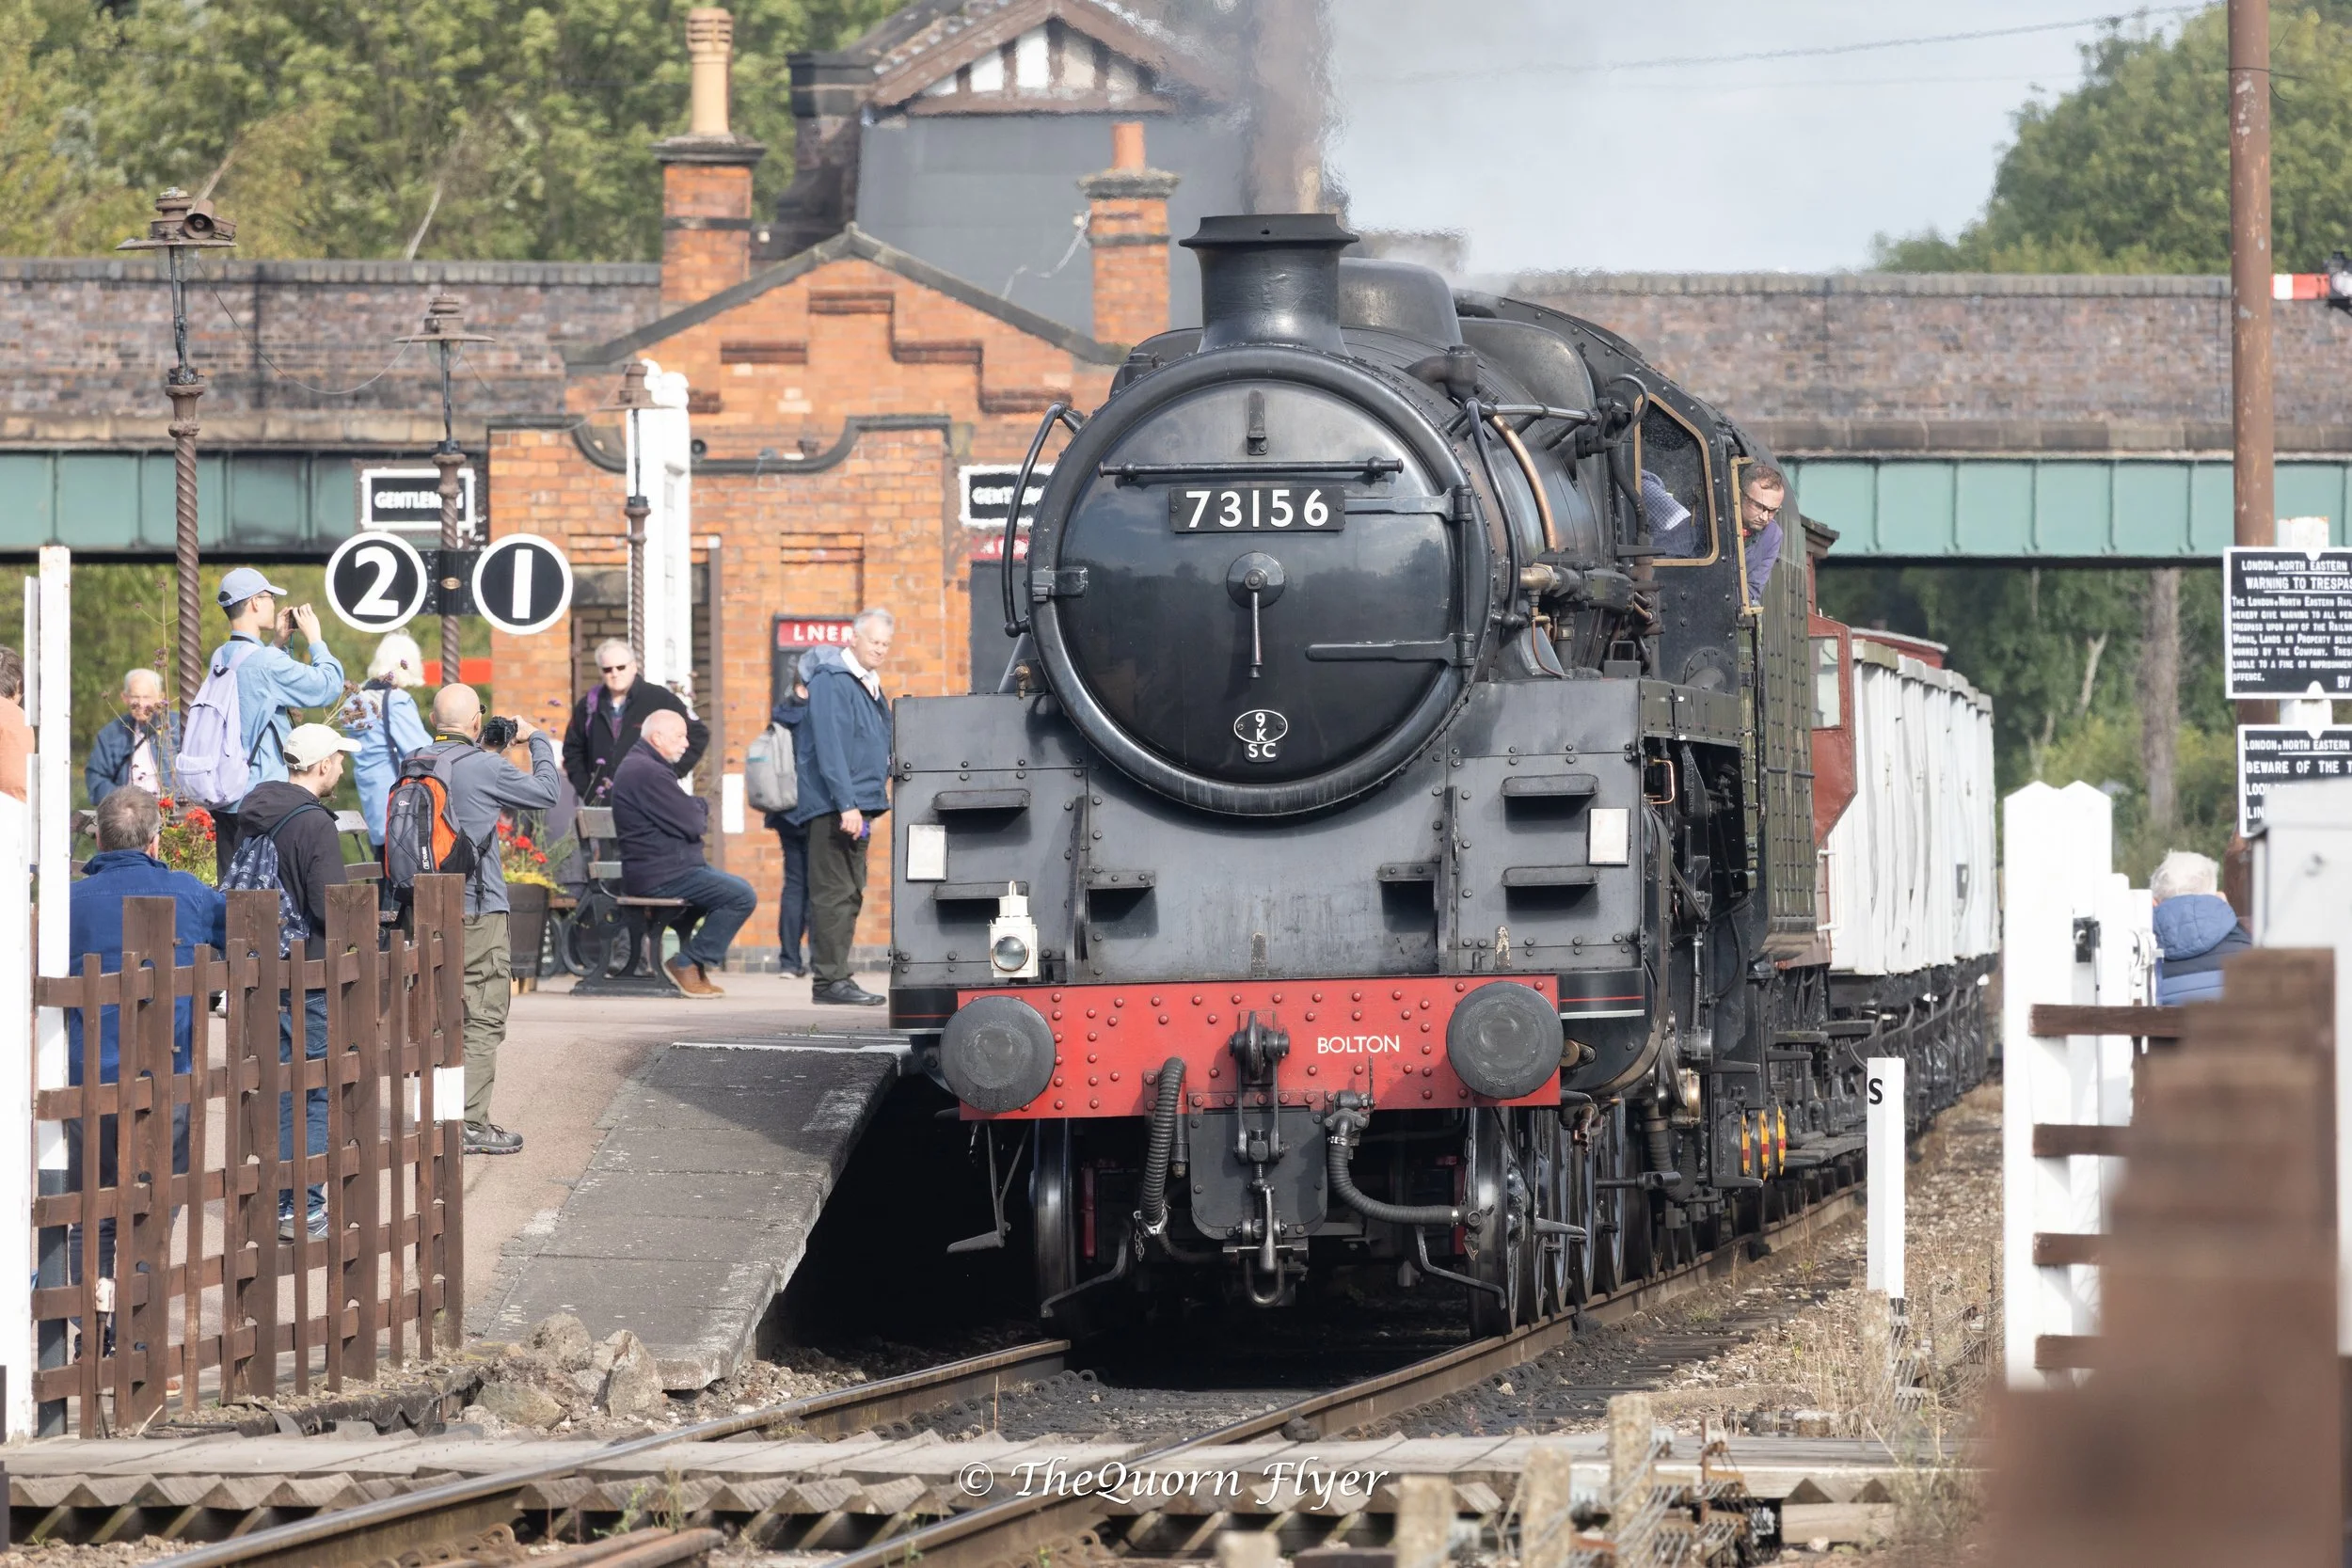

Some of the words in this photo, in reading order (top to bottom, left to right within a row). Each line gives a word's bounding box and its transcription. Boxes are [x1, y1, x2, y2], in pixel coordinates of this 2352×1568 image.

[374, 491, 463, 509] GENTLEMN
[1186, 489, 1328, 528] 73156
[2241, 560, 2274, 571] LONDON
[2279, 560, 2306, 571] NORTH
[2310, 560, 2348, 571] EASTERN
[353, 546, 399, 617] 2
[512, 549, 533, 619] 1
[2245, 577, 2289, 590] WARNING
[2292, 577, 2306, 590] TO
[794, 624, 853, 643] LNER
[2337, 675, 2351, 689] BY
[1255, 712, 1265, 728] 9
[1256, 728, 1267, 741] K
[2245, 740, 2276, 751] LONDON
[2282, 740, 2310, 750] NORTH
[2313, 740, 2350, 750] EASTERN
[2246, 761, 2289, 774] BEWARE
[2296, 761, 2311, 773] OF
[2318, 761, 2339, 773] THE
[1317, 1035, 1400, 1054] BOLTON
[1868, 1078, 1883, 1105] S
